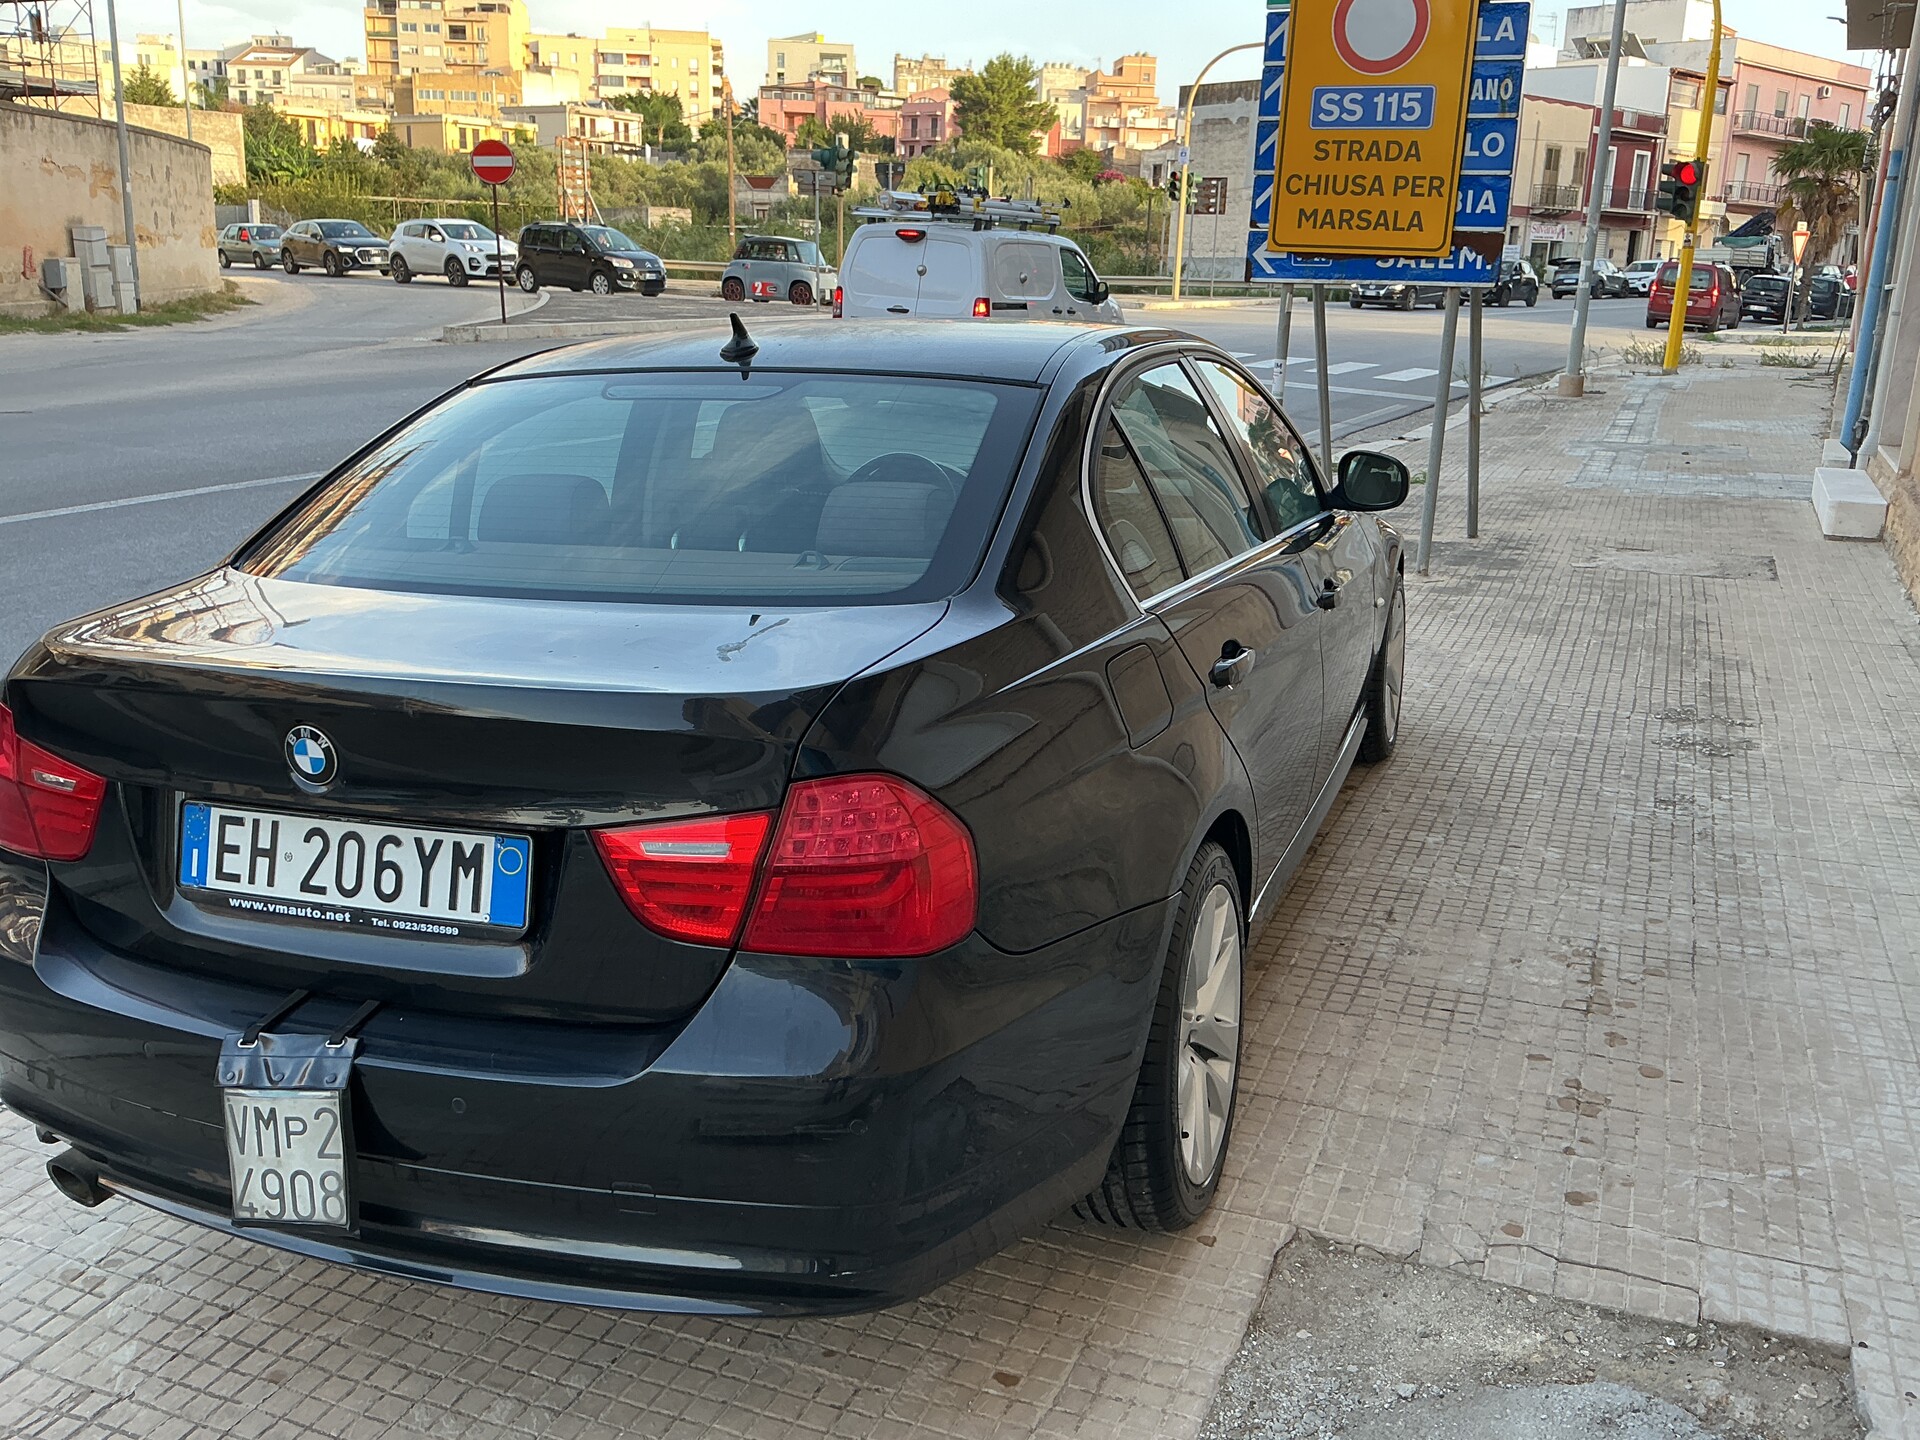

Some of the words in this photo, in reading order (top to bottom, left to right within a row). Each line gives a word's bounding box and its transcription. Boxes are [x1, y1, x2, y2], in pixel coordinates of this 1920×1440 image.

[1318, 92, 1363, 121] SS
[1373, 91, 1422, 122] 115
[1313, 140, 1421, 161] STRADA
[1285, 173, 1384, 196] CHIUSA
[1392, 175, 1446, 198] PER
[1297, 208, 1424, 232] MARSALA
[287, 728, 329, 749] BMW
[215, 815, 280, 887] EH
[299, 827, 484, 913] 206YM
[228, 897, 351, 923] www.vmauto.net
[371, 918, 390, 928] Tel.
[392, 920, 459, 936] 0923/526599
[238, 1168, 344, 1221] 4908
